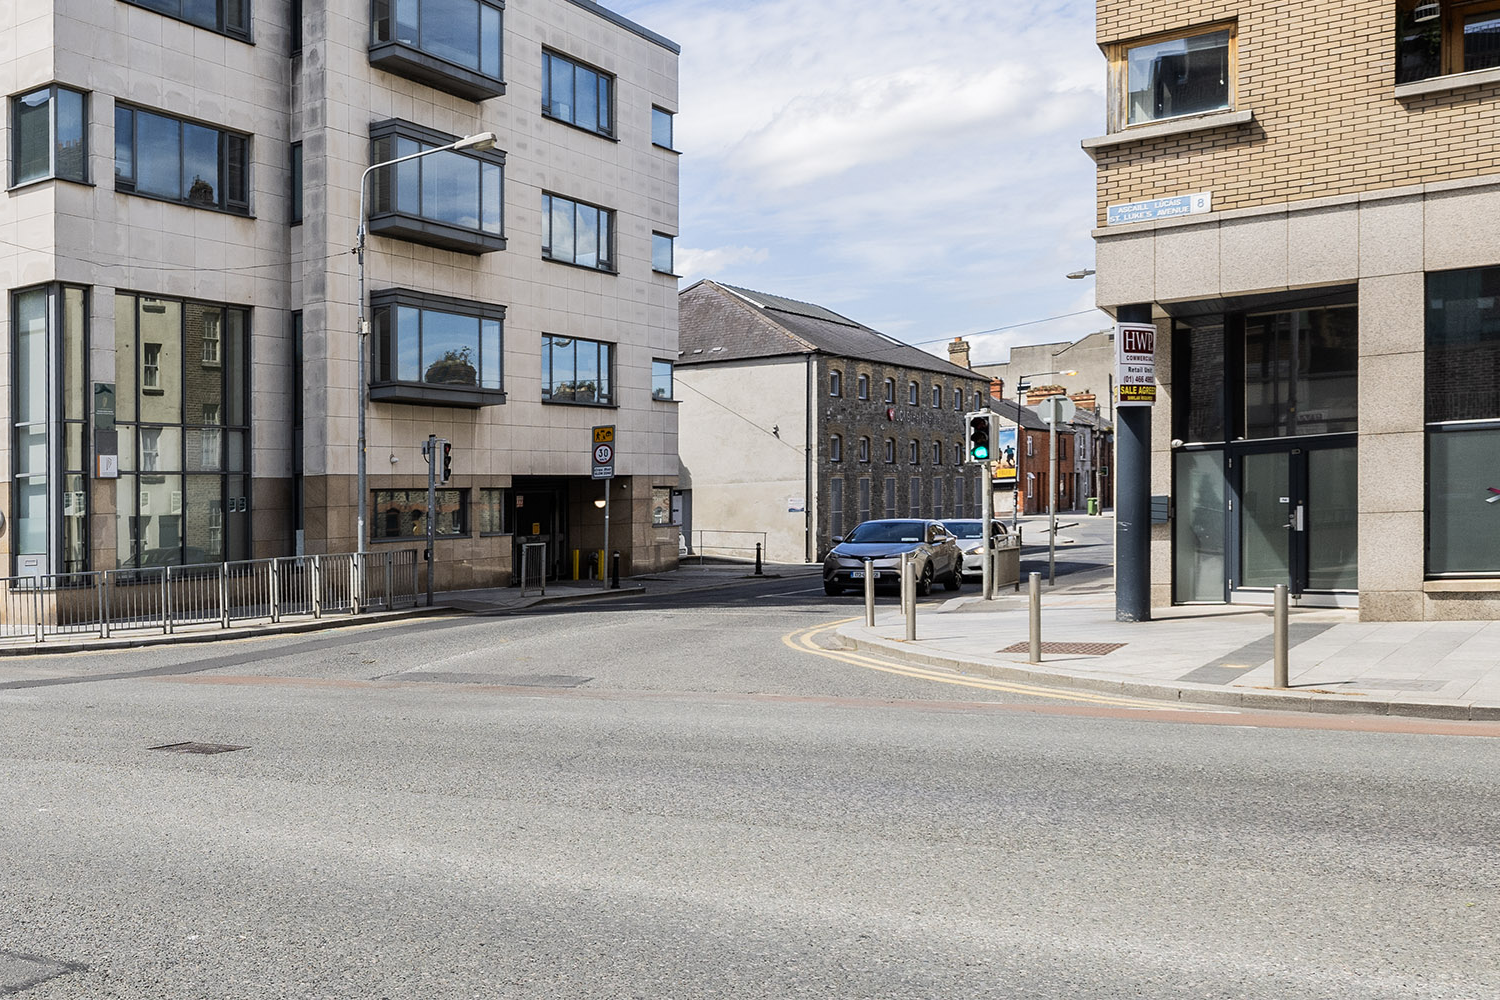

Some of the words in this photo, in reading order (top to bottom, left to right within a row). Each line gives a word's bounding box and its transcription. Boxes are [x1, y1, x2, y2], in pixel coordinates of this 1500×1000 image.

[1118, 204, 1149, 213] ASCAILL
[1198, 199, 1204, 207] 8
[1124, 211, 1152, 221] LUKE'S
[1157, 206, 1189, 216] AVENUE
[1123, 375, 1134, 384] (01)
[1120, 386, 1137, 395] SALE
[599, 449, 608, 457] 30
